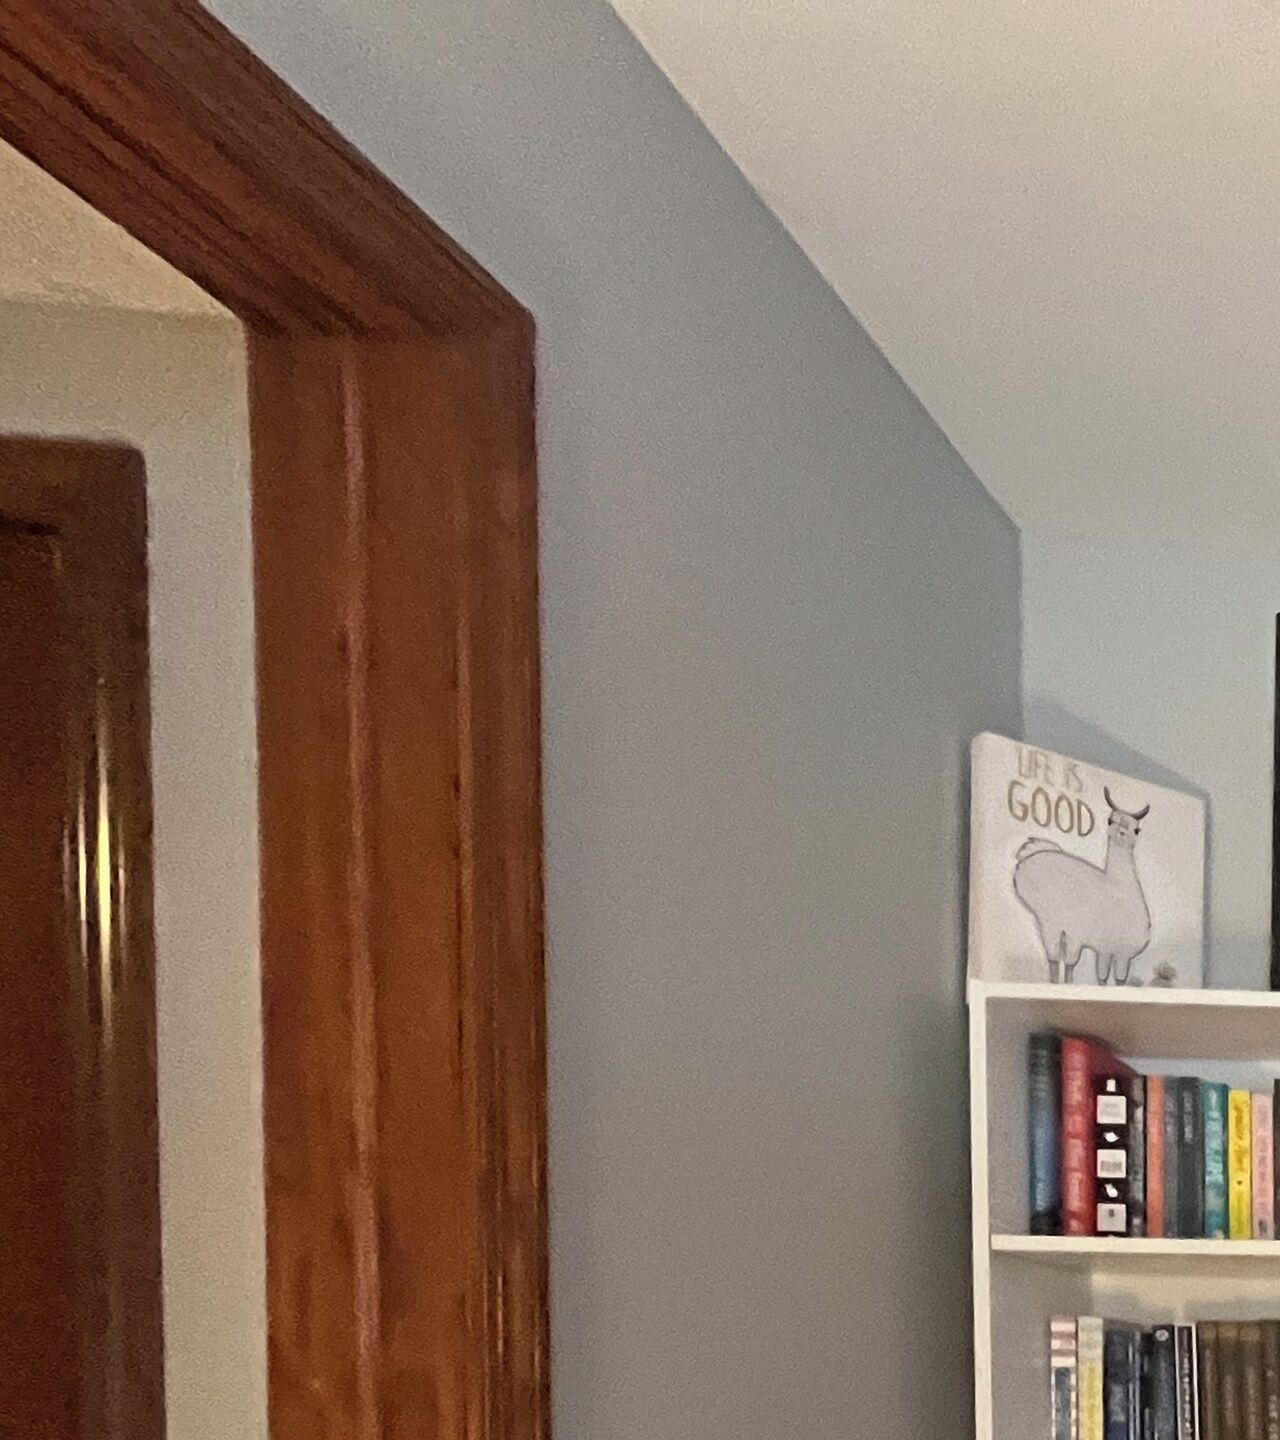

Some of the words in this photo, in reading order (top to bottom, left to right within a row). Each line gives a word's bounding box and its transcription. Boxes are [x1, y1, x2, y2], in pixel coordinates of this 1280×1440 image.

[1016, 748, 1061, 782] LIFE
[1063, 758, 1083, 790] IS
[1007, 779, 1096, 838] GOOD
